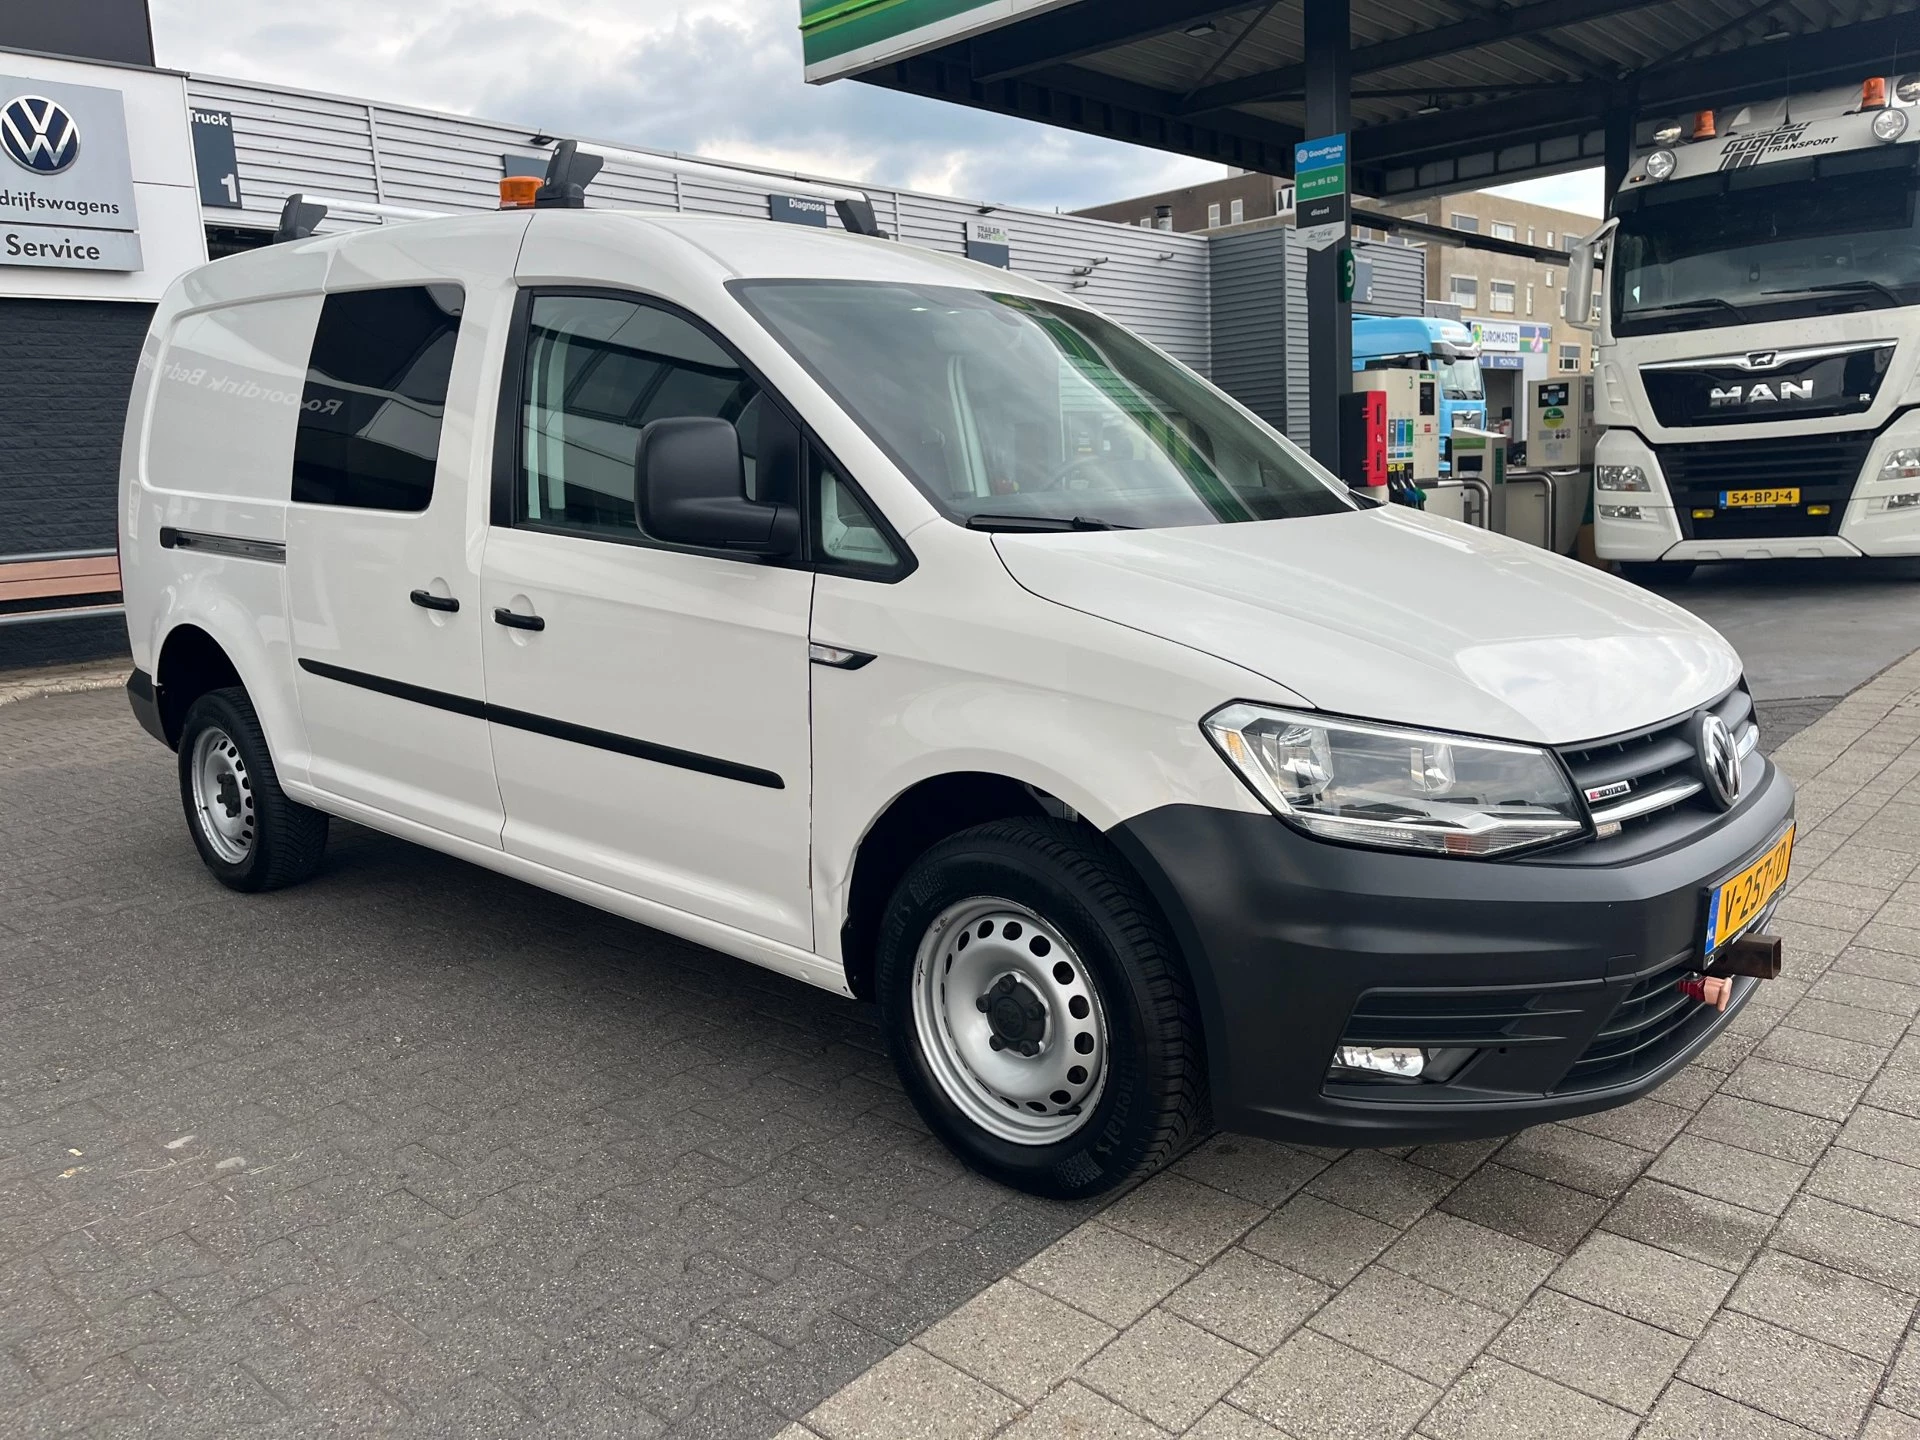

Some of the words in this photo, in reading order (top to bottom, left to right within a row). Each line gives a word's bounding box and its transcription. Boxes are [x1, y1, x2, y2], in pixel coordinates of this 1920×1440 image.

[190, 109, 229, 126] Truck
[1309, 145, 1343, 158] GoodFuels
[1767, 136, 1839, 153] TRANSPORT
[221, 173, 238, 203] 1
[1302, 181, 1317, 189] euro
[1327, 175, 1339, 183] E10
[0, 190, 120, 216] drijfswagens
[788, 198, 825, 212] Diagnose
[1310, 206, 1330, 216] diesel
[977, 225, 1000, 235] TRAILER
[6, 233, 101, 261] Service
[1346, 259, 1355, 288] 3
[1482, 330, 1518, 344] EUROMASTER
[1408, 375, 1414, 390] 3
[1710, 379, 1814, 408] MAN
[1732, 490, 1793, 504] 54-BPJ-4
[1706, 926, 1715, 943] NL
